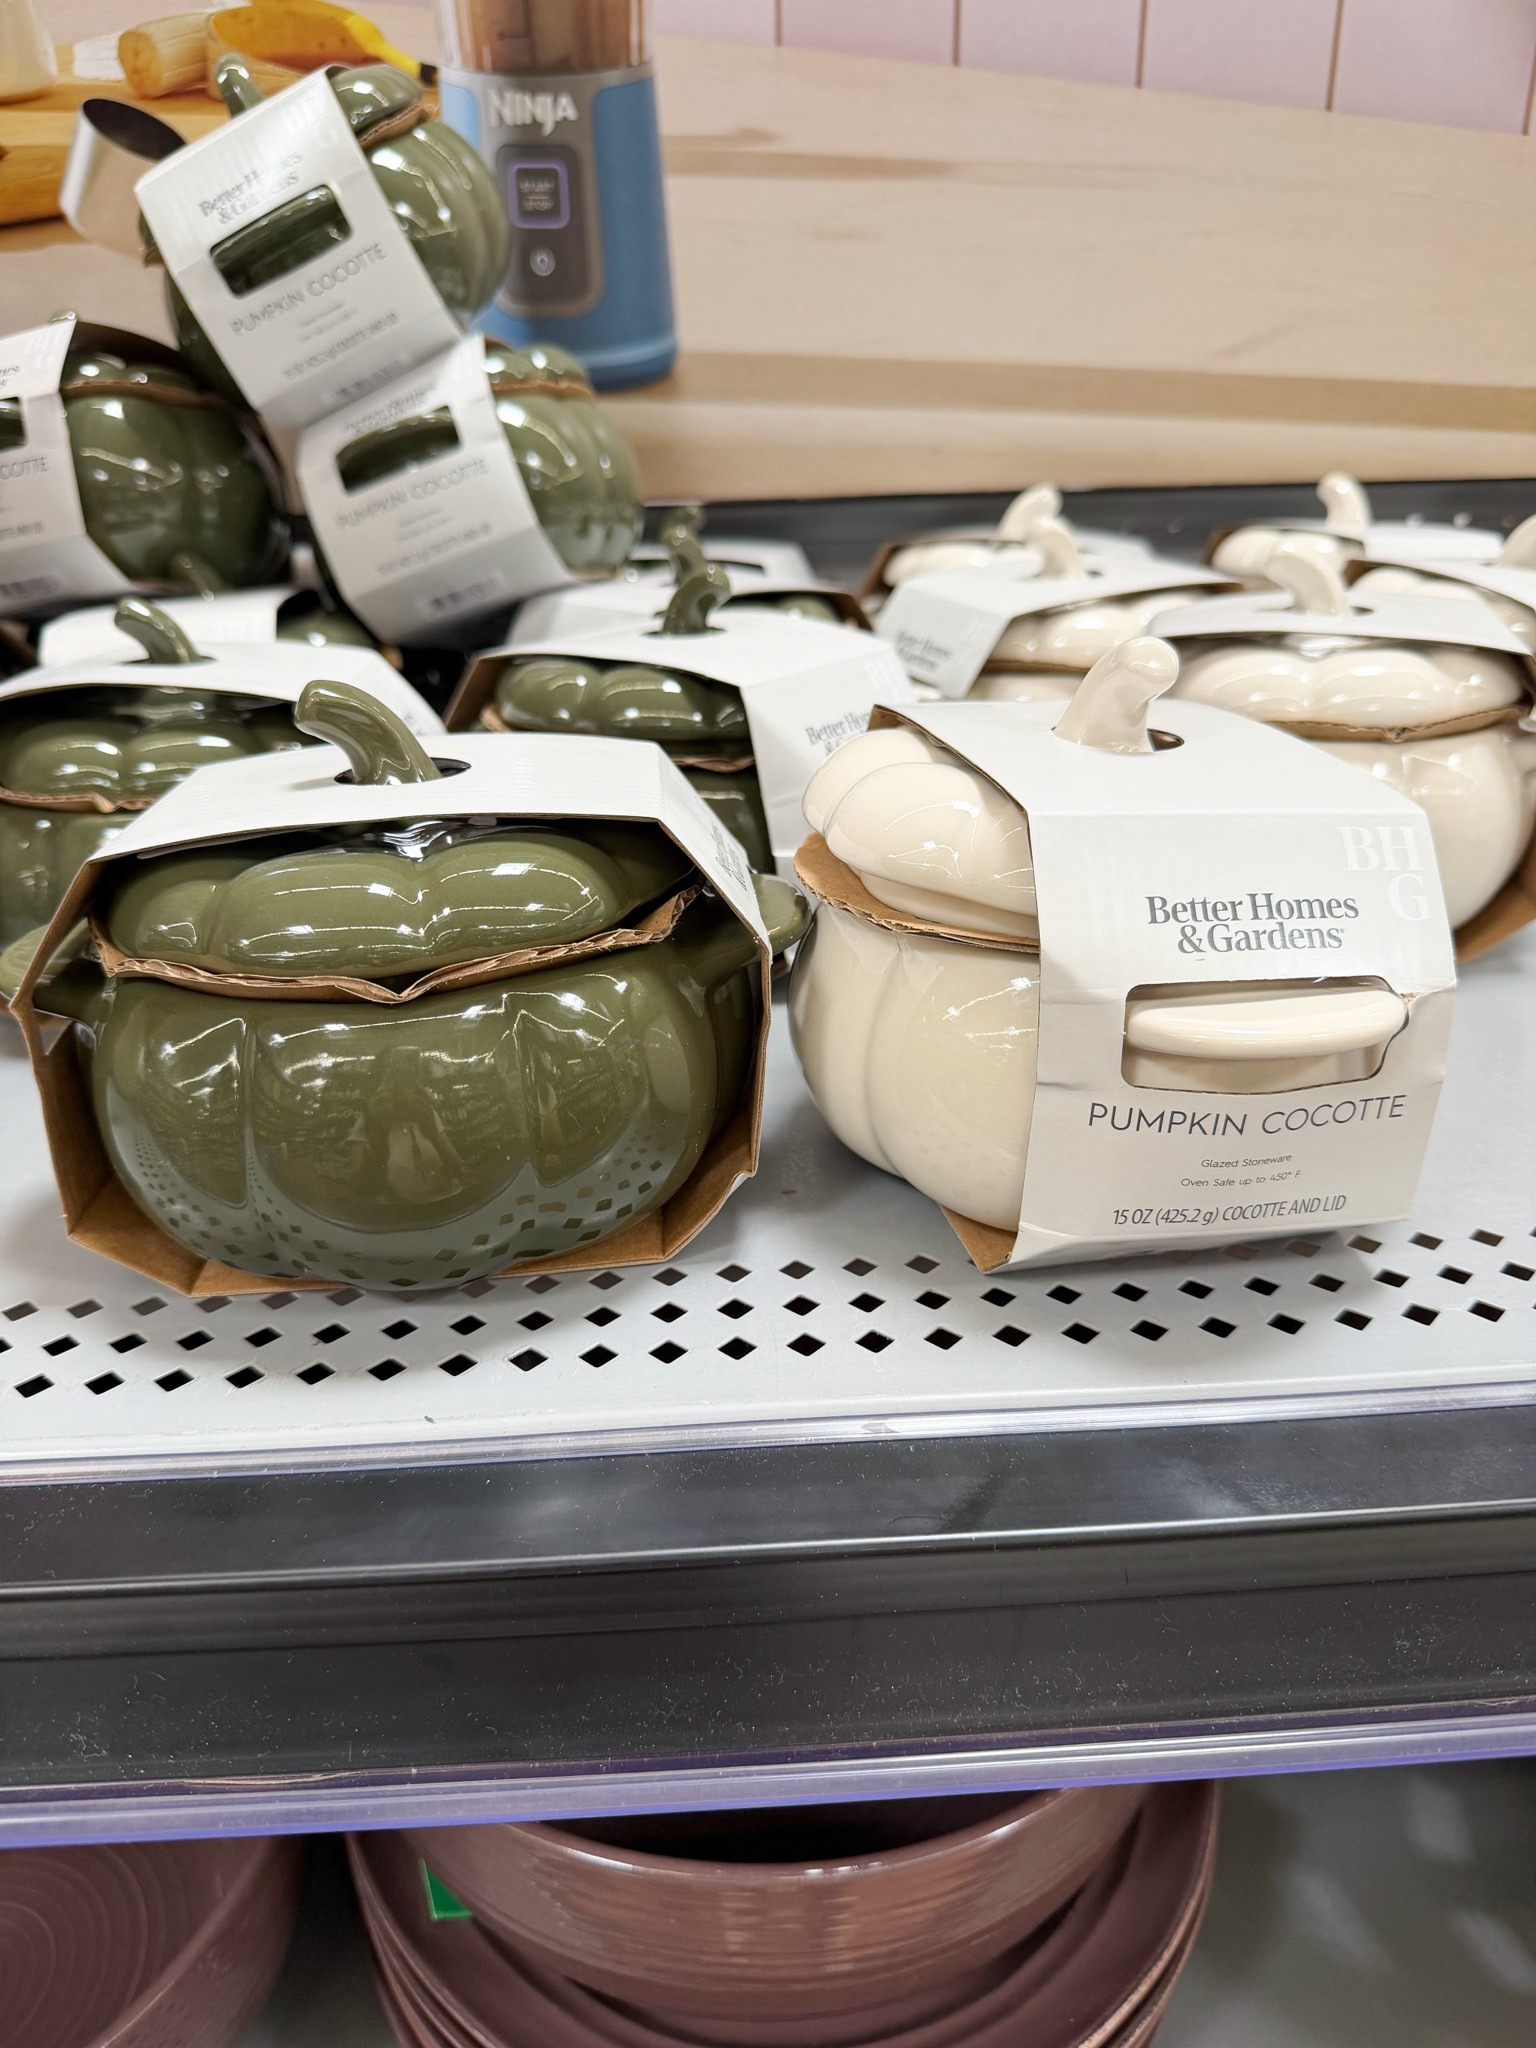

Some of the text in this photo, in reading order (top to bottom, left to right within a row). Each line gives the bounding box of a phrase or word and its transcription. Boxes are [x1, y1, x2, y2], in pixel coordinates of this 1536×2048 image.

[489, 89, 580, 136] NINJA
[307, 240, 389, 298] COCOTTE
[805, 720, 846, 746] Better
[1145, 893, 1359, 925] Better Homes
[1088, 1095, 1406, 1136] PUMPKIN COCOTTE
[1201, 1153, 1292, 1169] Glazed Stoneware
[1180, 1177, 1209, 1188] Oven
[1212, 1176, 1235, 1188] Safe
[1238, 1177, 1252, 1187] up
[1255, 1175, 1266, 1184] to
[1294, 1169, 1302, 1179] F
[1113, 1195, 1347, 1226] 15 OZ (425.2 g) COCOTTE AND LID
